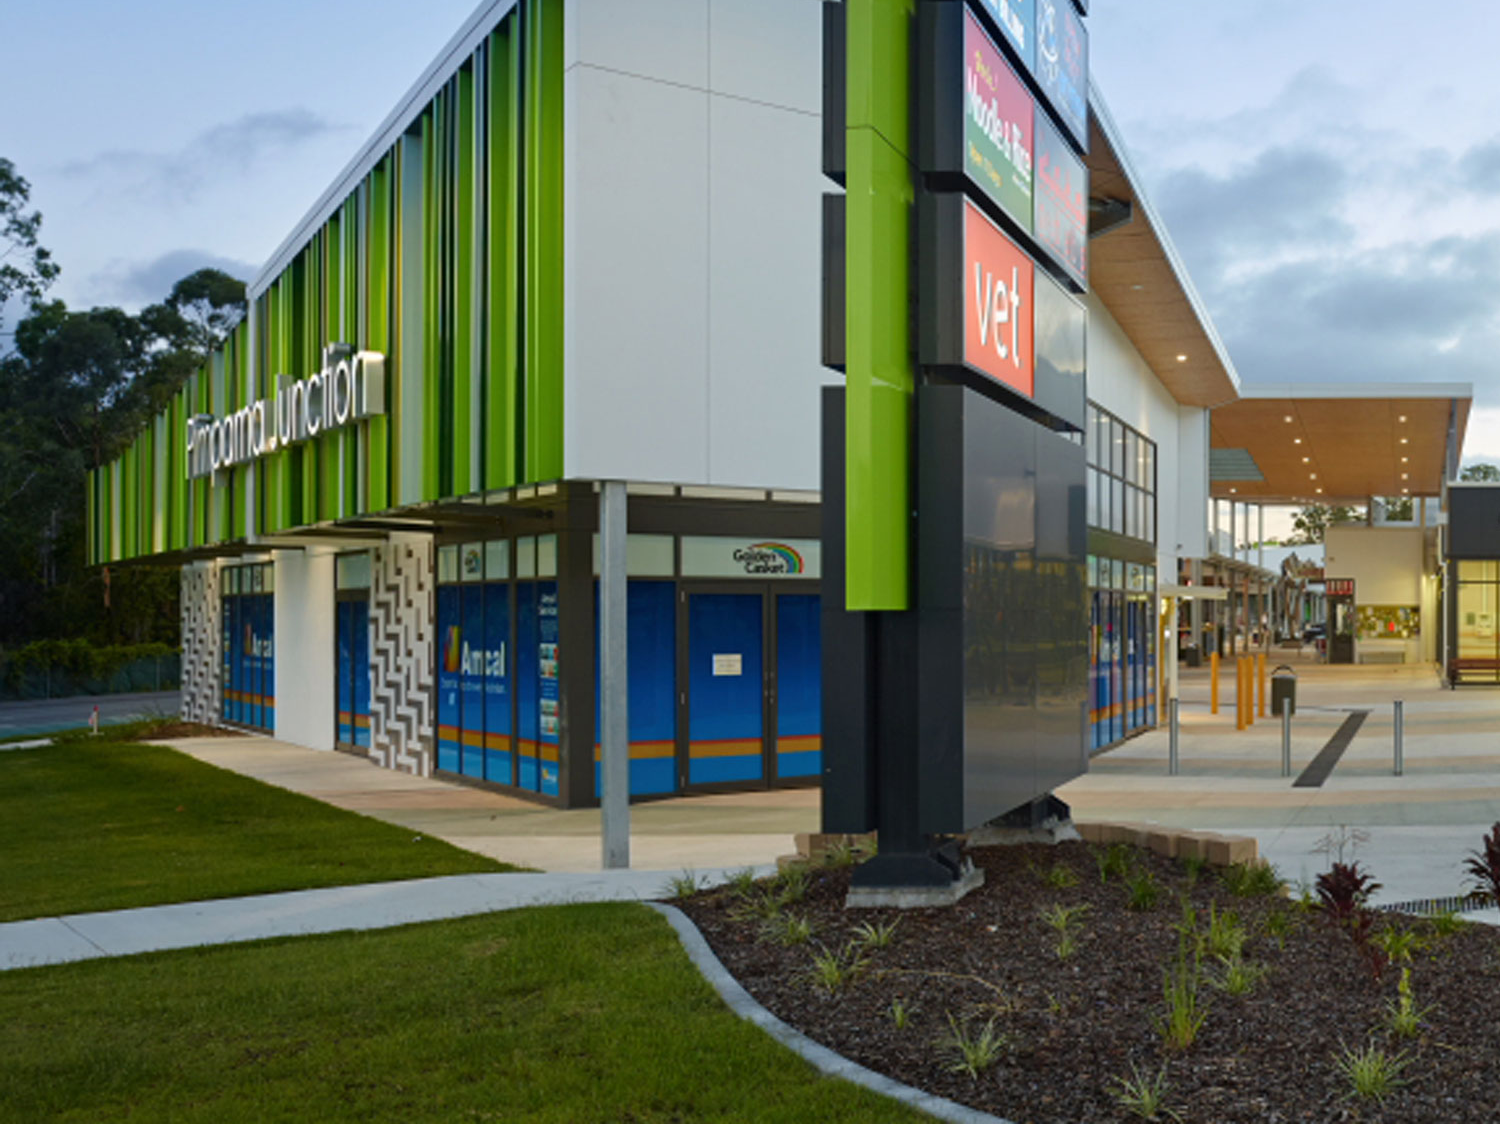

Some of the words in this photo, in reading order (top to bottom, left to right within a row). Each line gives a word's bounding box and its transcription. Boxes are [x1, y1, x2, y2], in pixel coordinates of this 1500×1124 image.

[974, 262, 1020, 368] vet
[186, 399, 271, 487] Pimpama
[270, 343, 376, 451] Junction
[733, 548, 777, 562] Golden
[460, 640, 505, 677] Amcal
